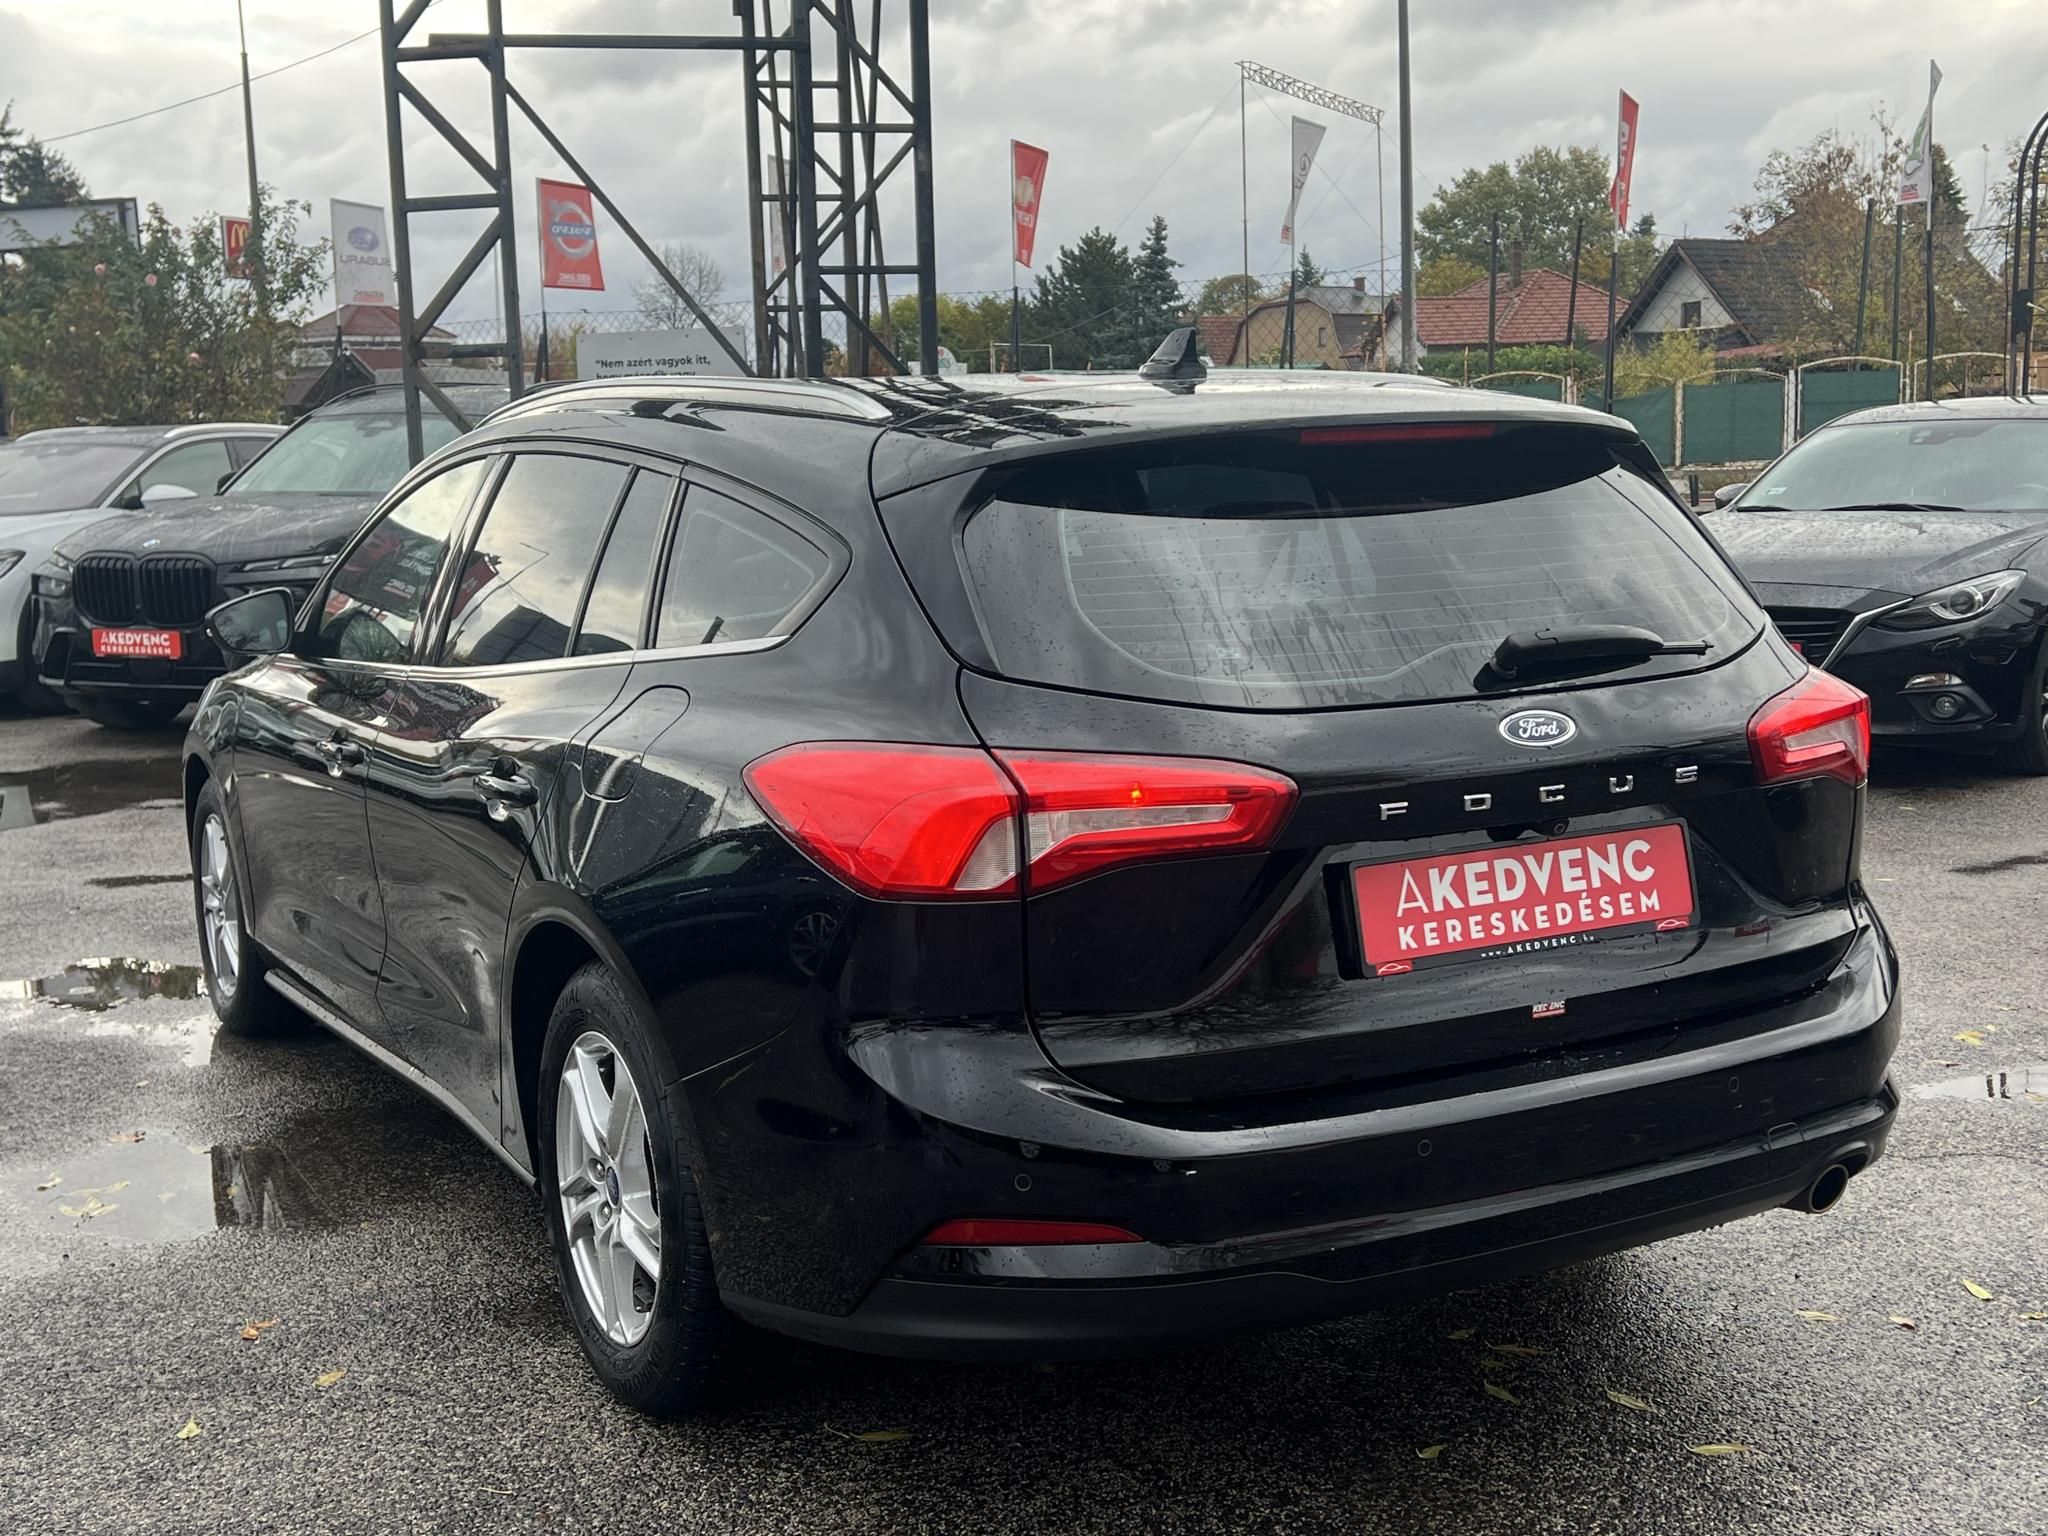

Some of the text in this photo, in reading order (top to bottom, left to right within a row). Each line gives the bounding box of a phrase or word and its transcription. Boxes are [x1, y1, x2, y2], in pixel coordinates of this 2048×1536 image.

[626, 358, 653, 367] azért
[655, 356, 692, 367] vagyok
[695, 355, 711, 366] itt,
[101, 632, 170, 646] AKEDVENC
[1518, 717, 1560, 739] Ford
[1380, 766, 1698, 821] FOCUS
[1396, 840, 1655, 917] AKEDVENC
[1398, 890, 1661, 951] KERESKEDÉSEM
